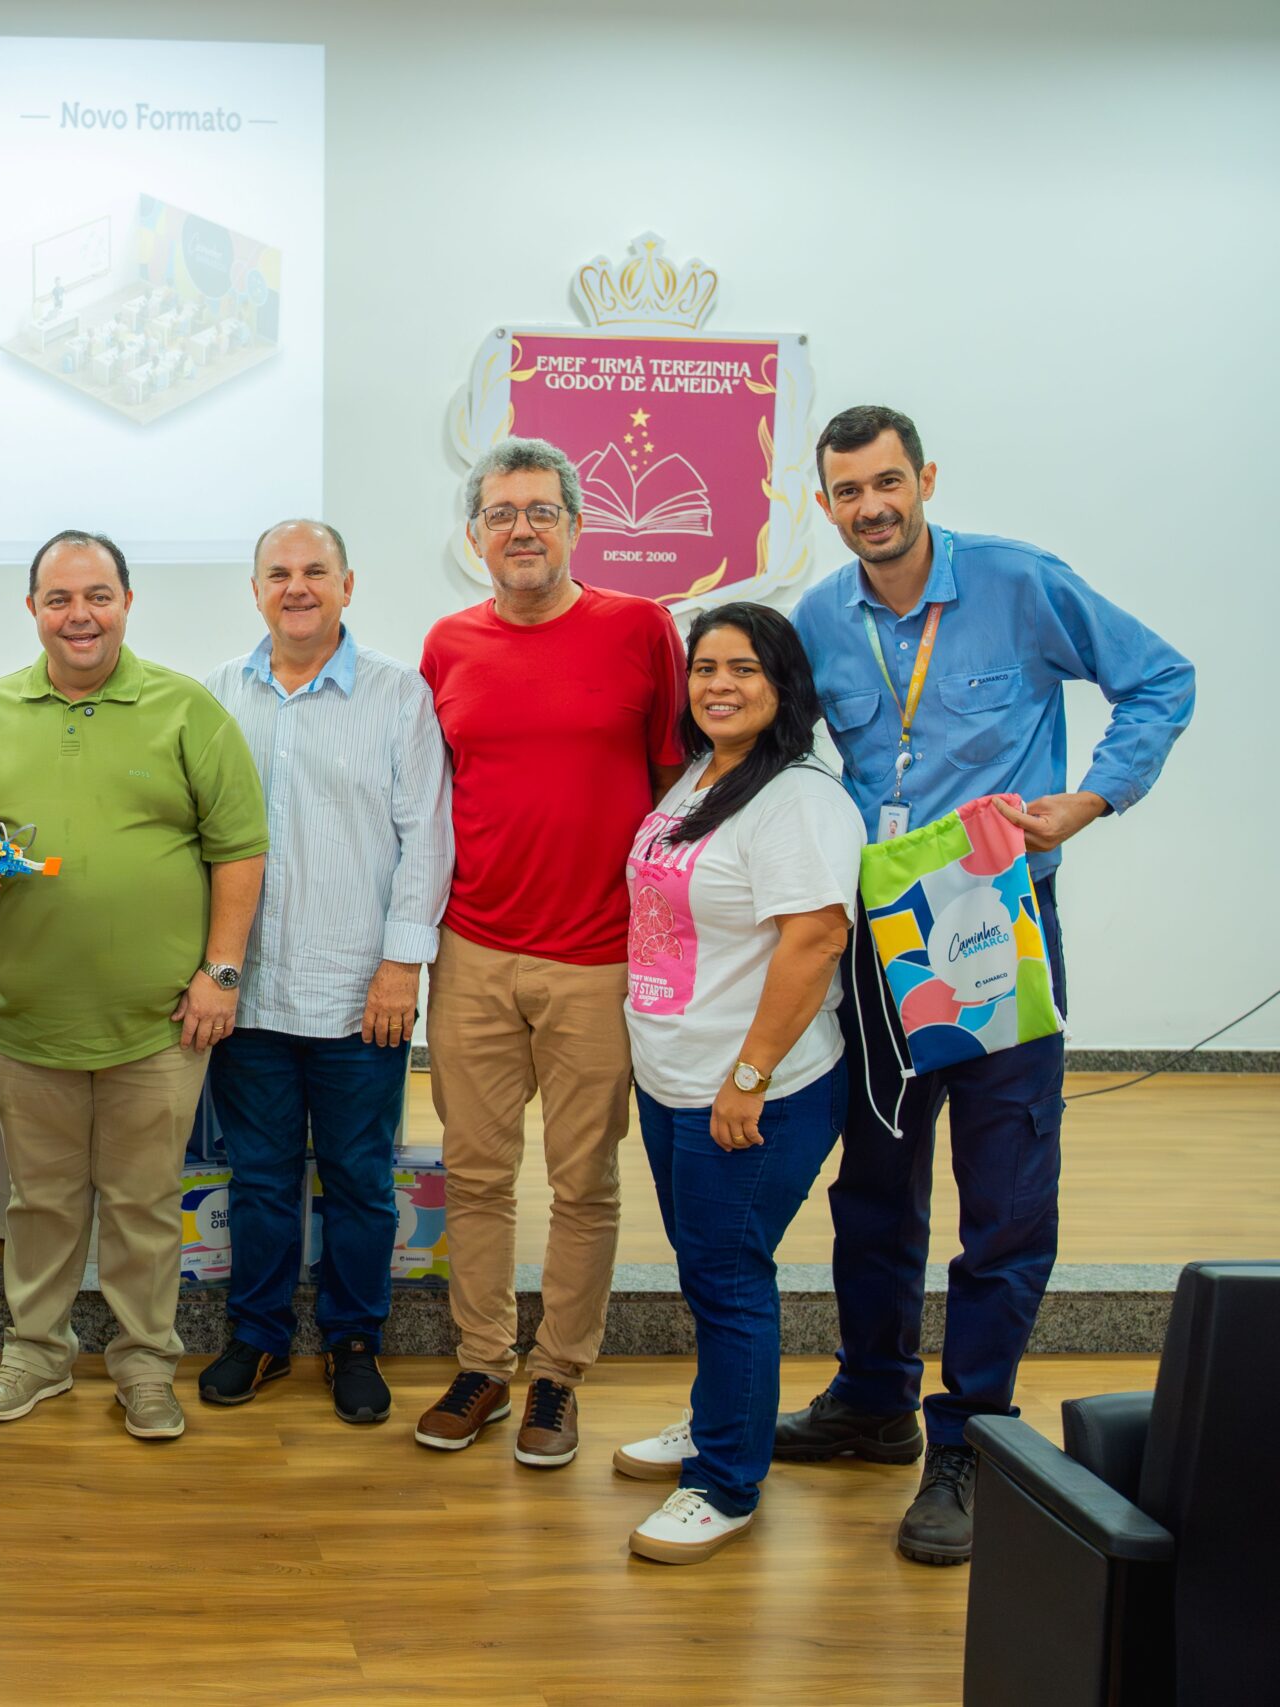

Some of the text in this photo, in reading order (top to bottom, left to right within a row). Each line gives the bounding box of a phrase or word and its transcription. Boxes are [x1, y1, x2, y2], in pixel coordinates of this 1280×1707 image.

[60, 101, 242, 132] Novo Formato
[536, 356, 587, 372] EMEF
[649, 359, 752, 378] TEREZINHA
[545, 373, 616, 391] GODOY
[620, 376, 646, 392] DE
[603, 550, 677, 562] DESDE 2000
[978, 674, 1009, 685] SAMARCO
[948, 921, 1001, 963] Caminhos
[962, 933, 1010, 958] SAMARCO
[982, 972, 1008, 985] SAMARCO
[639, 983, 674, 999] STARTED
